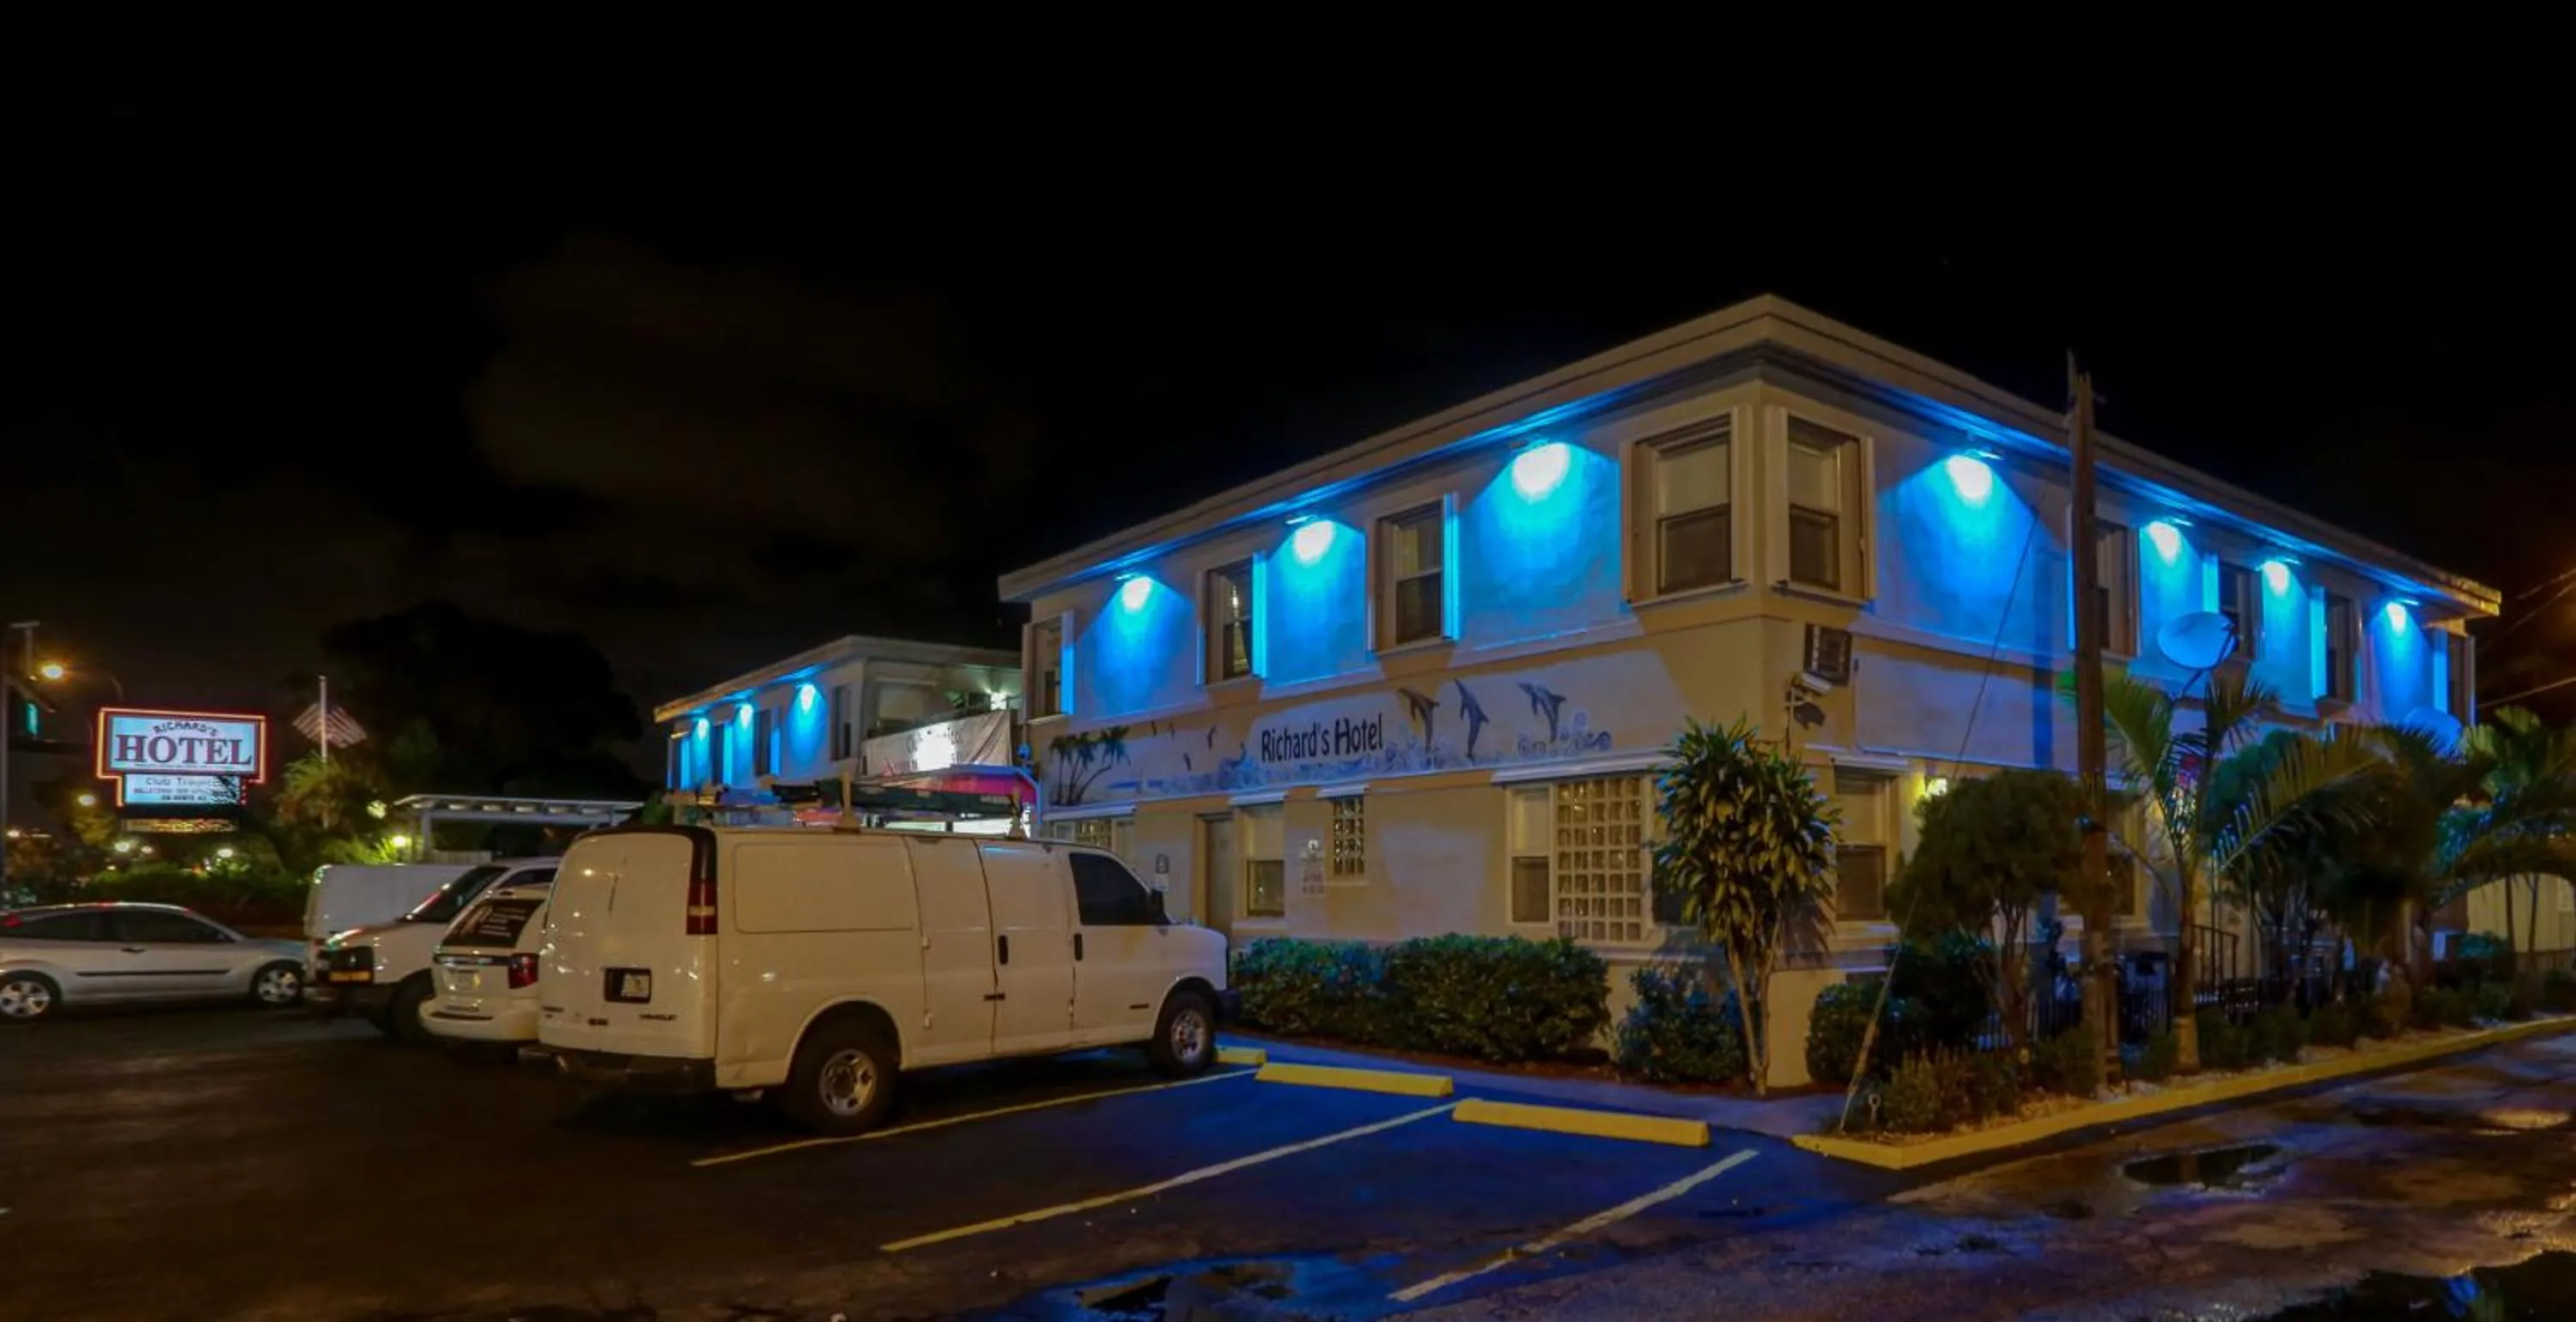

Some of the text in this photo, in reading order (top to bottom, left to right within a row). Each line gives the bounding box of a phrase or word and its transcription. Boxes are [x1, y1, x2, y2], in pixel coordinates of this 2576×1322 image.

[113, 735, 252, 765] HOTEL
[1261, 712, 1383, 762] Richard's Hotel
